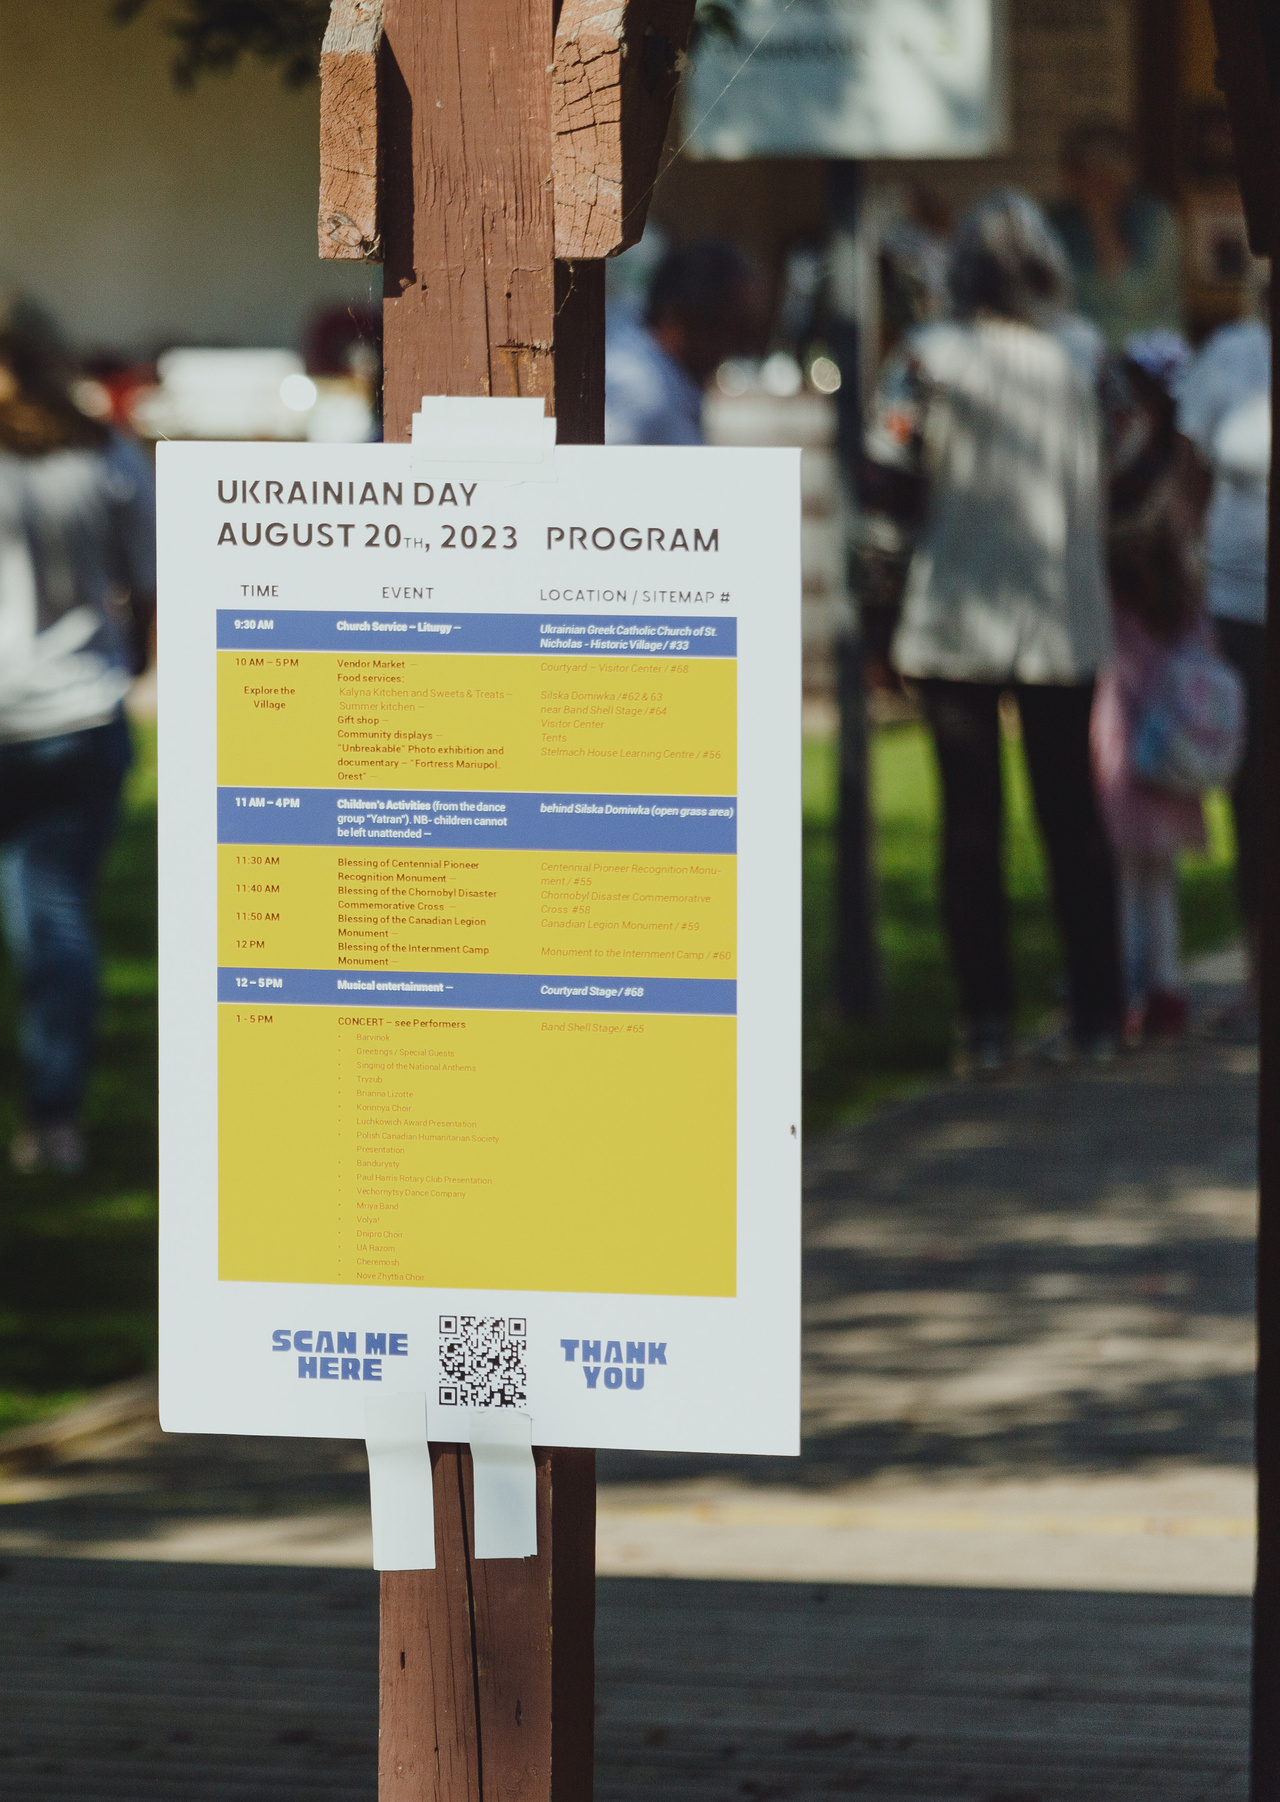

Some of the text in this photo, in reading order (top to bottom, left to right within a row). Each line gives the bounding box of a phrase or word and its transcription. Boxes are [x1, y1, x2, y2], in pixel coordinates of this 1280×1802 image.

[218, 480, 477, 506] UKRAINIAN DAY
[217, 522, 355, 547] AUGUST
[441, 524, 517, 549] 2023
[547, 526, 718, 551] PROGRAM
[240, 585, 278, 597] TIME
[382, 586, 434, 599] EVENT
[540, 589, 714, 603] LOCATION SITEMAP
[234, 619, 273, 629] 9:30 AM
[336, 620, 452, 634] Church Service Liturgy
[540, 624, 586, 635] Ukrainian
[587, 625, 616, 636] Greek
[616, 625, 656, 636] Catholic
[656, 626, 692, 637] Church
[692, 626, 705, 637] of
[540, 638, 689, 651] Nicholas Historic Village #33
[236, 658, 298, 666] 10 AM PM
[337, 659, 404, 668] Vendor Market
[337, 673, 404, 682] Food services:
[244, 686, 295, 696] Explore the
[338, 687, 504, 699] Kalyna Kitchen and Sweets Treats
[253, 700, 286, 710] Village
[337, 715, 379, 726] Gift shop
[337, 729, 432, 741] Community displays
[408, 744, 436, 753] Photo
[437, 745, 484, 754] exhibition
[486, 746, 504, 754] and
[337, 757, 399, 769] documentary
[235, 797, 265, 807] 11 AM
[386, 800, 431, 810] Activities
[459, 801, 475, 812] the
[476, 802, 506, 811] dance
[540, 803, 574, 814] behind
[574, 804, 604, 815] Silska
[604, 804, 650, 818] Domiwka
[679, 808, 707, 818] grass
[337, 815, 365, 825] group
[434, 815, 472, 825] children
[473, 817, 507, 826] cannot
[337, 827, 422, 838] be left unattended
[236, 856, 280, 864] 11:30 AM
[338, 858, 479, 869] Blessing of Centennial Pioneer
[338, 872, 446, 883] Recognition Monument
[236, 884, 279, 892] 11:40 AM
[338, 886, 496, 898] Blessing of the Chornobyl Disaster
[338, 900, 444, 910] Commemorative Cross
[236, 912, 280, 920] 11:50 AM
[338, 914, 486, 927] Blessing of the Canadian Legion
[338, 928, 388, 937] Monument
[236, 940, 264, 948] 12 PM
[338, 942, 489, 955] Blessing of the Internment Camp
[338, 956, 388, 965] Monument
[337, 980, 444, 992] Musical entertainment
[540, 985, 644, 998] Courtyard Stage #68
[338, 1017, 383, 1026] CONCERT
[413, 1018, 466, 1028] Performers
[272, 1329, 408, 1357] SCAN ME
[560, 1339, 667, 1365] THANK
[298, 1357, 382, 1381] HERE
[582, 1366, 644, 1390] YOU
